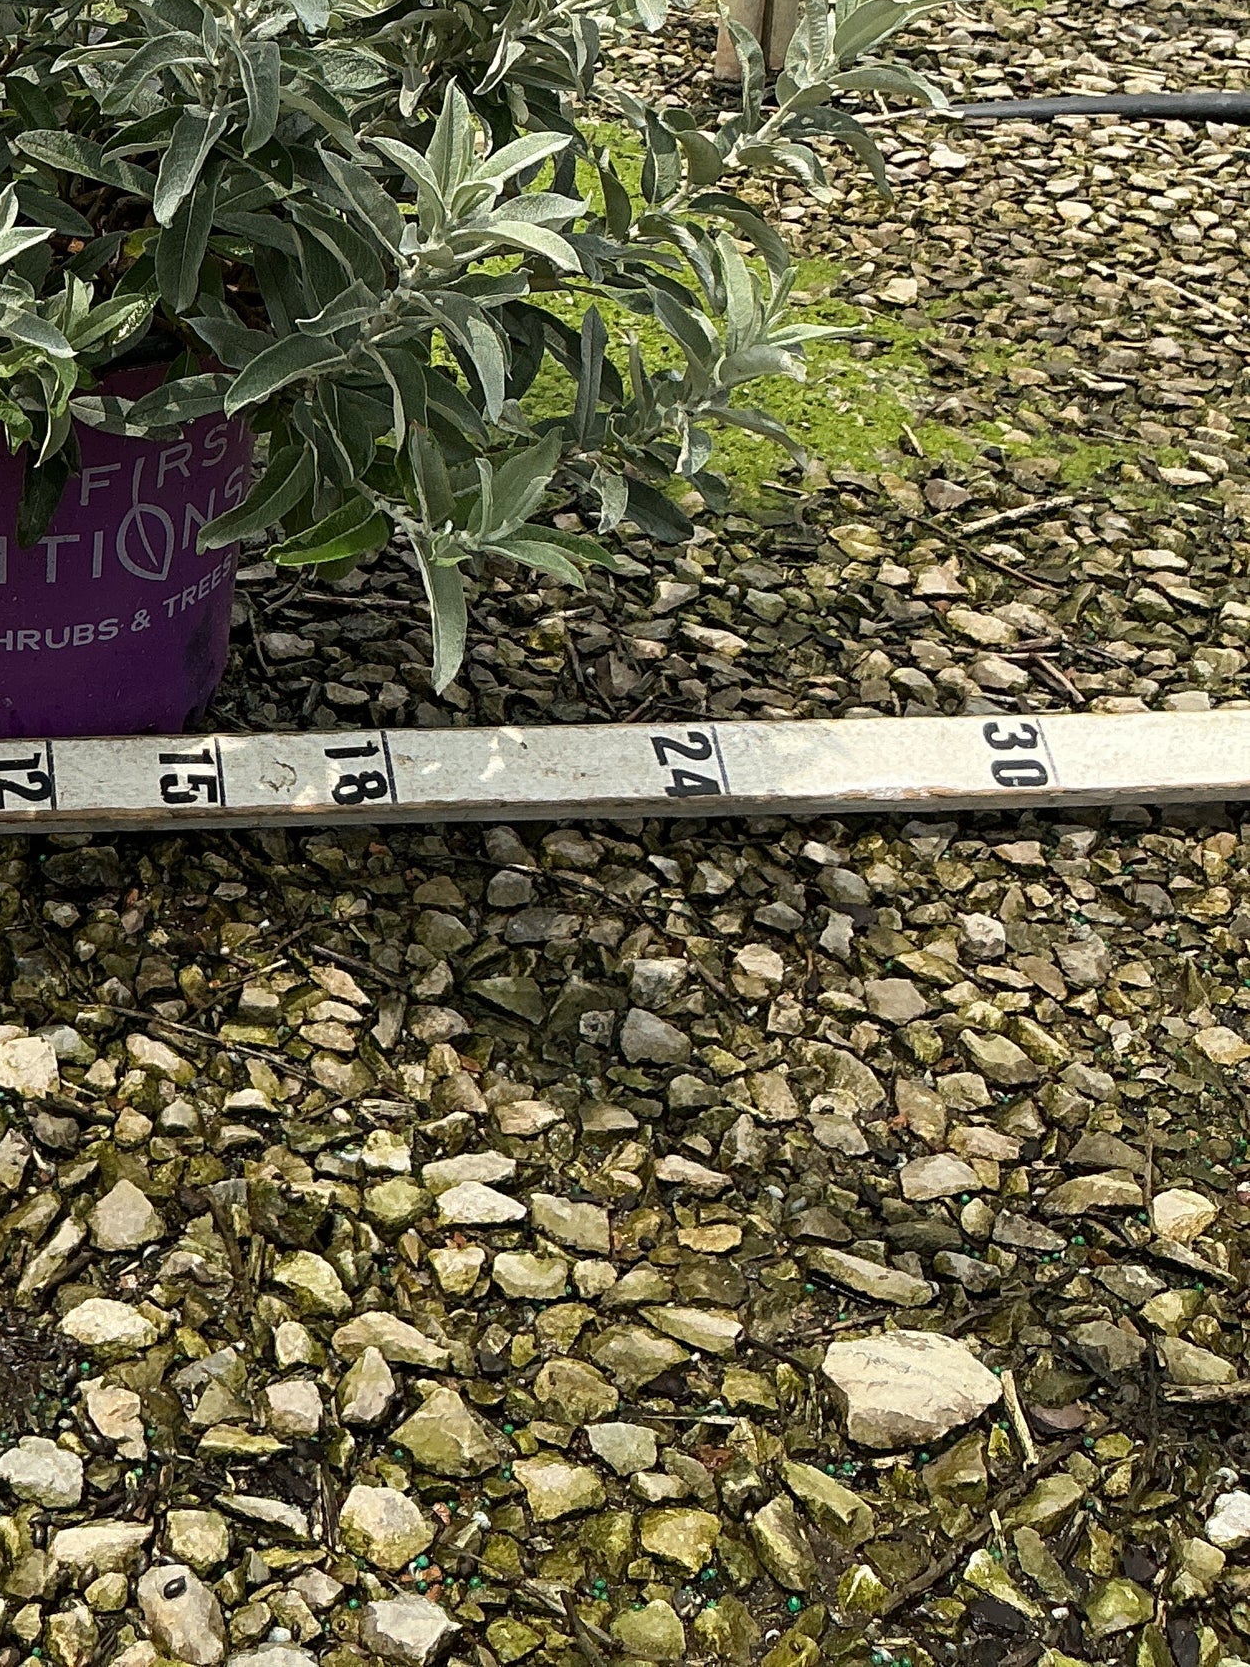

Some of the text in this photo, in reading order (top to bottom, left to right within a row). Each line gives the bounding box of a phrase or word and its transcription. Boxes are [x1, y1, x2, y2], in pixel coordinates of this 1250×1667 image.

[130, 609, 152, 632] &
[162, 553, 233, 619] TREES
[159, 749, 219, 804] 15
[324, 740, 389, 805] 18
[650, 730, 722, 797] 24
[982, 722, 1048, 786] 30
